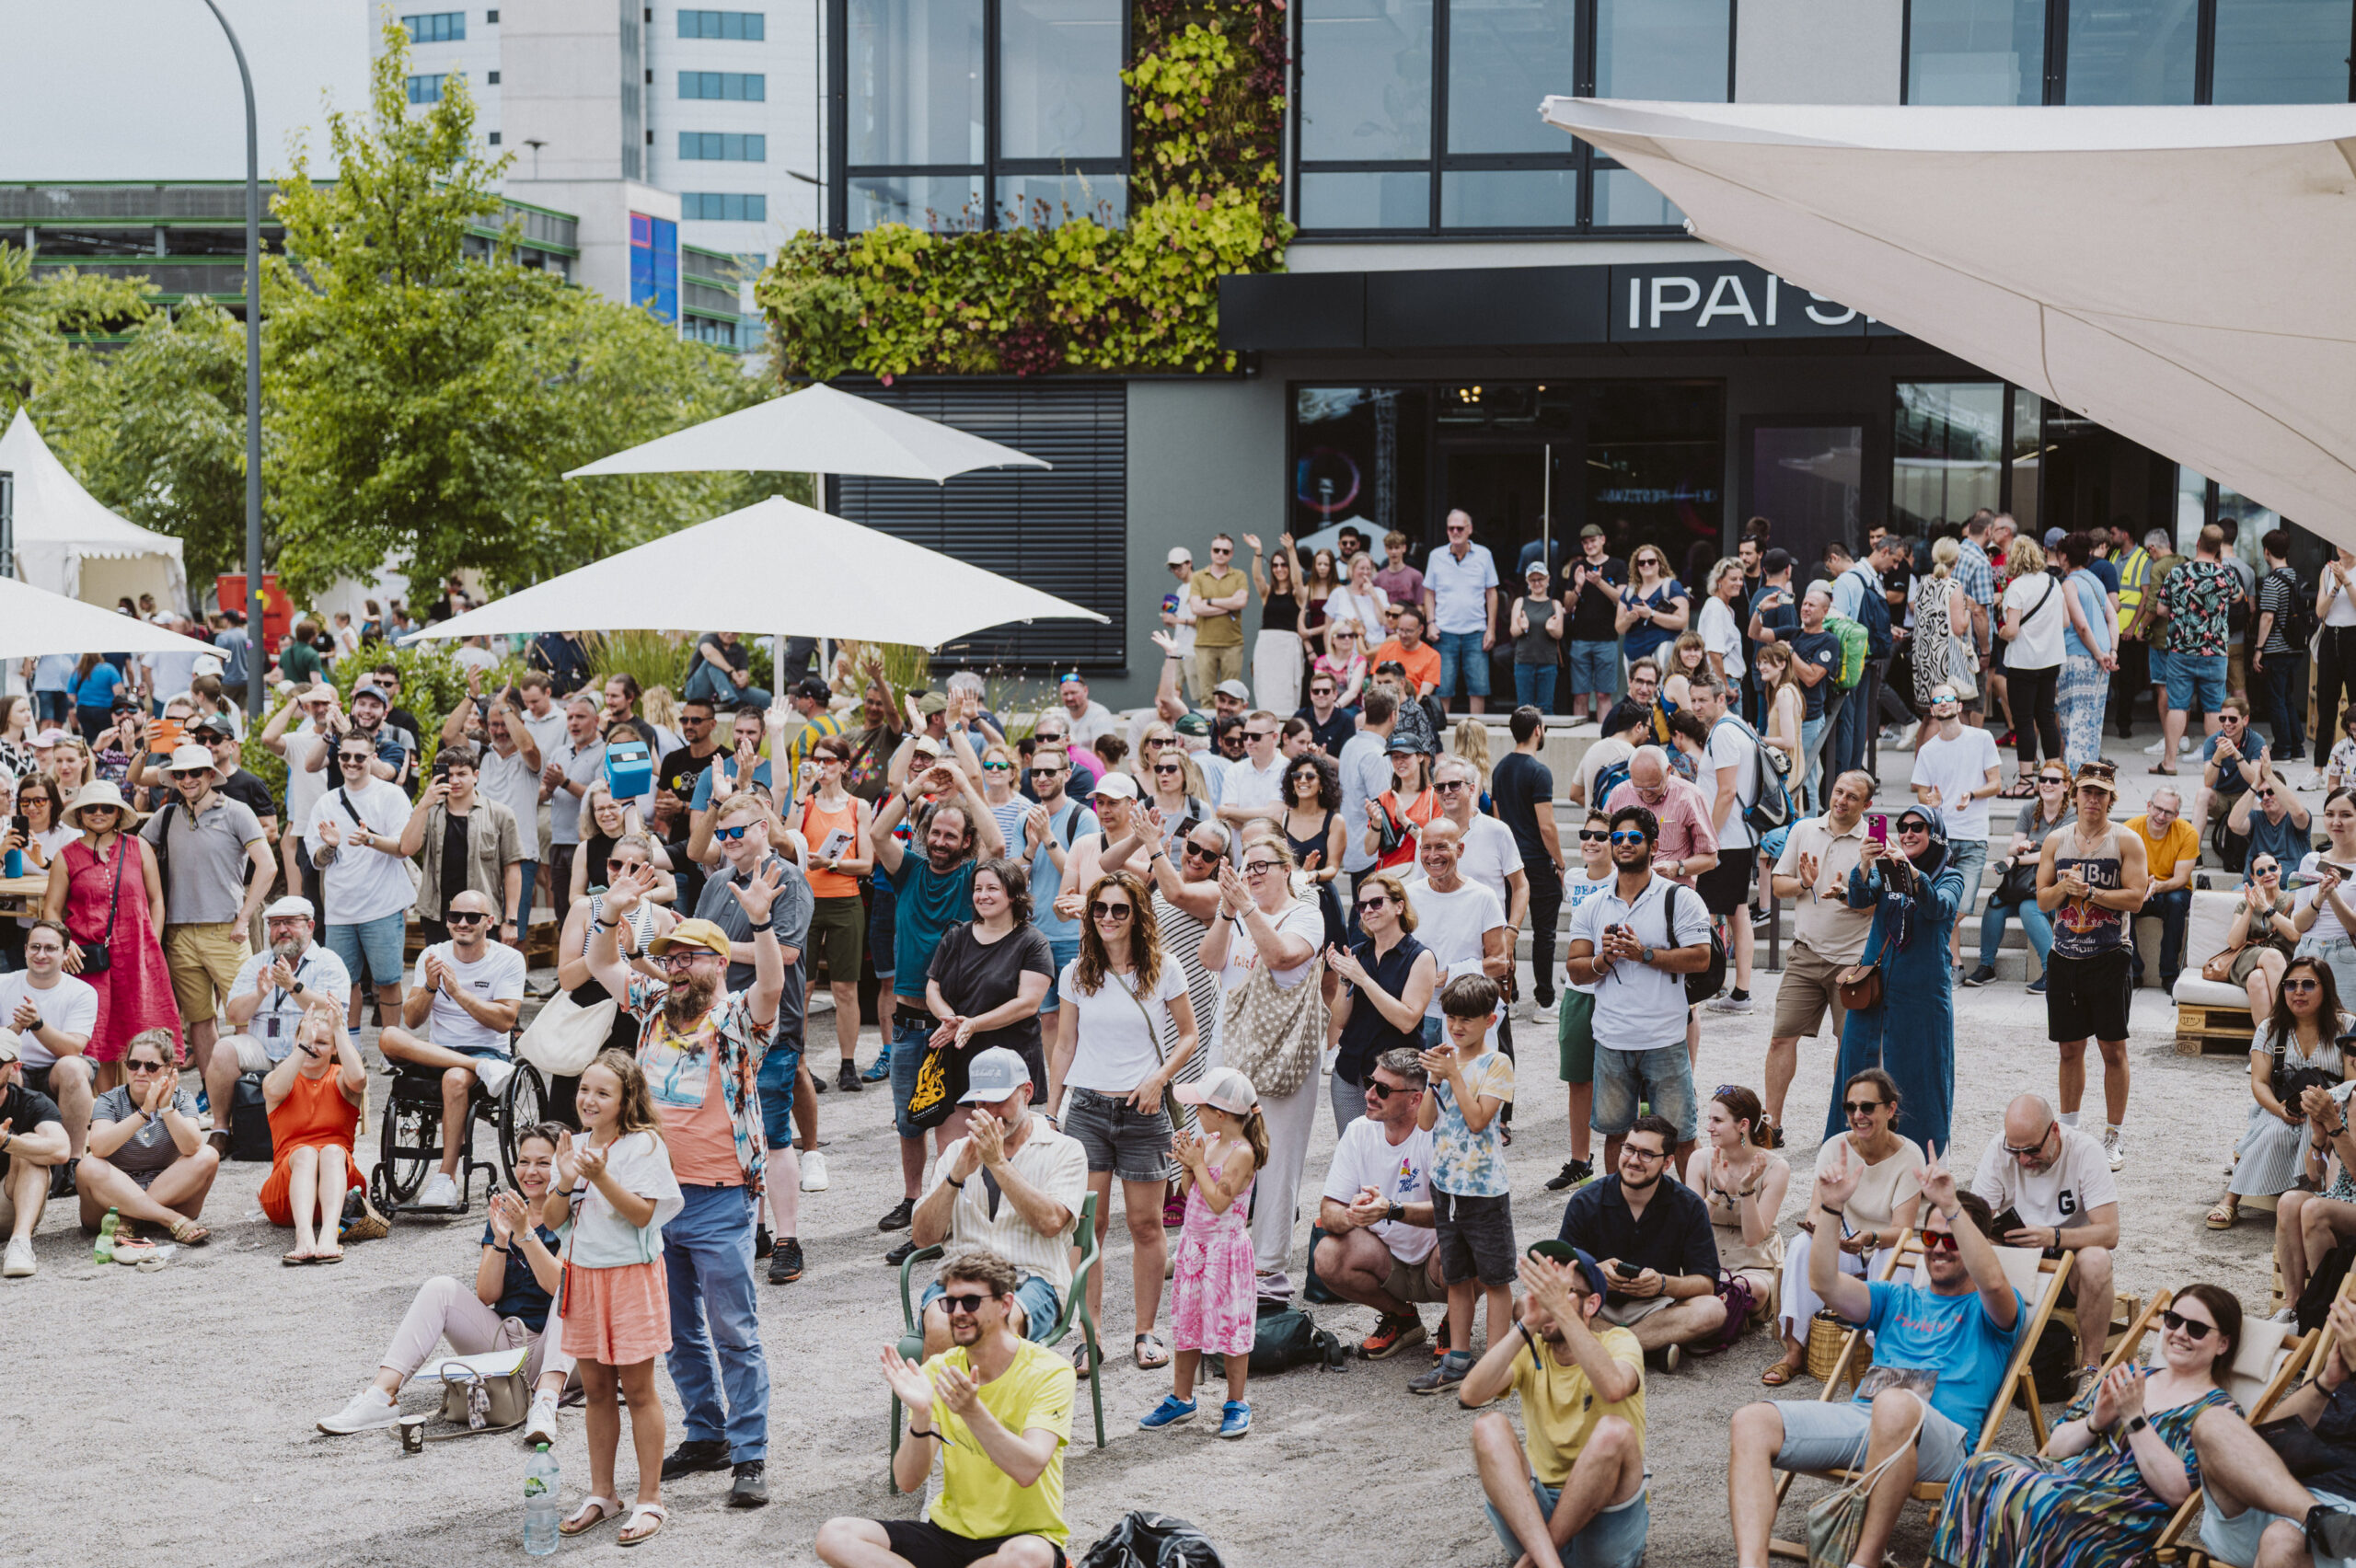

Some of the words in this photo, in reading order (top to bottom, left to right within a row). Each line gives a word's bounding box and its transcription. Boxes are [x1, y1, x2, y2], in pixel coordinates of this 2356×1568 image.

[1629, 274, 1778, 329] IPAI
[2087, 863, 2120, 889] Bull
[1574, 884, 1609, 895] BEA
[2058, 1189, 2076, 1216] G
